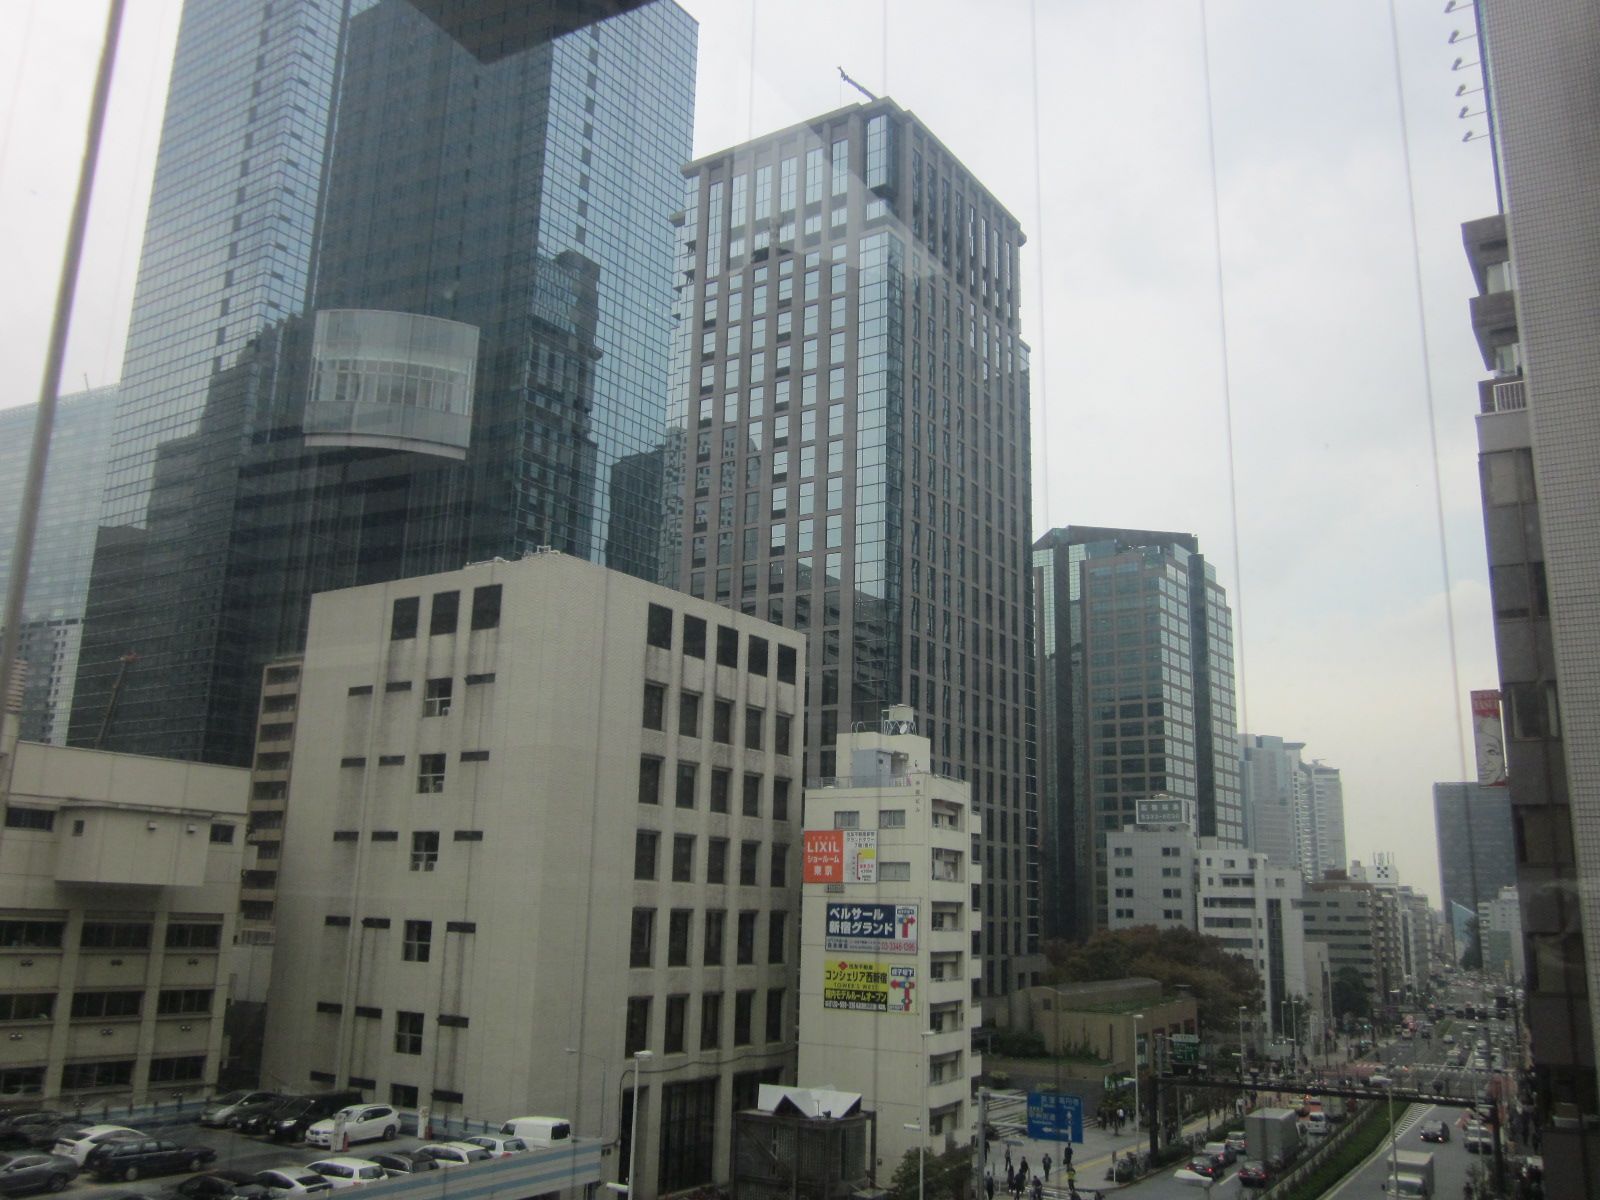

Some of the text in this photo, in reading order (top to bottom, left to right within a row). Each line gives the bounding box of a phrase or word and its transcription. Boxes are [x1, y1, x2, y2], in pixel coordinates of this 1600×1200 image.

[807, 841, 839, 852] LIXIL
[807, 855, 839, 864] ショールーム
[814, 866, 833, 876] 東京
[829, 908, 884, 920] ベルサール
[829, 921, 893, 935] 新宿グランド
[825, 970, 888, 984] コンシェリア西新宿
